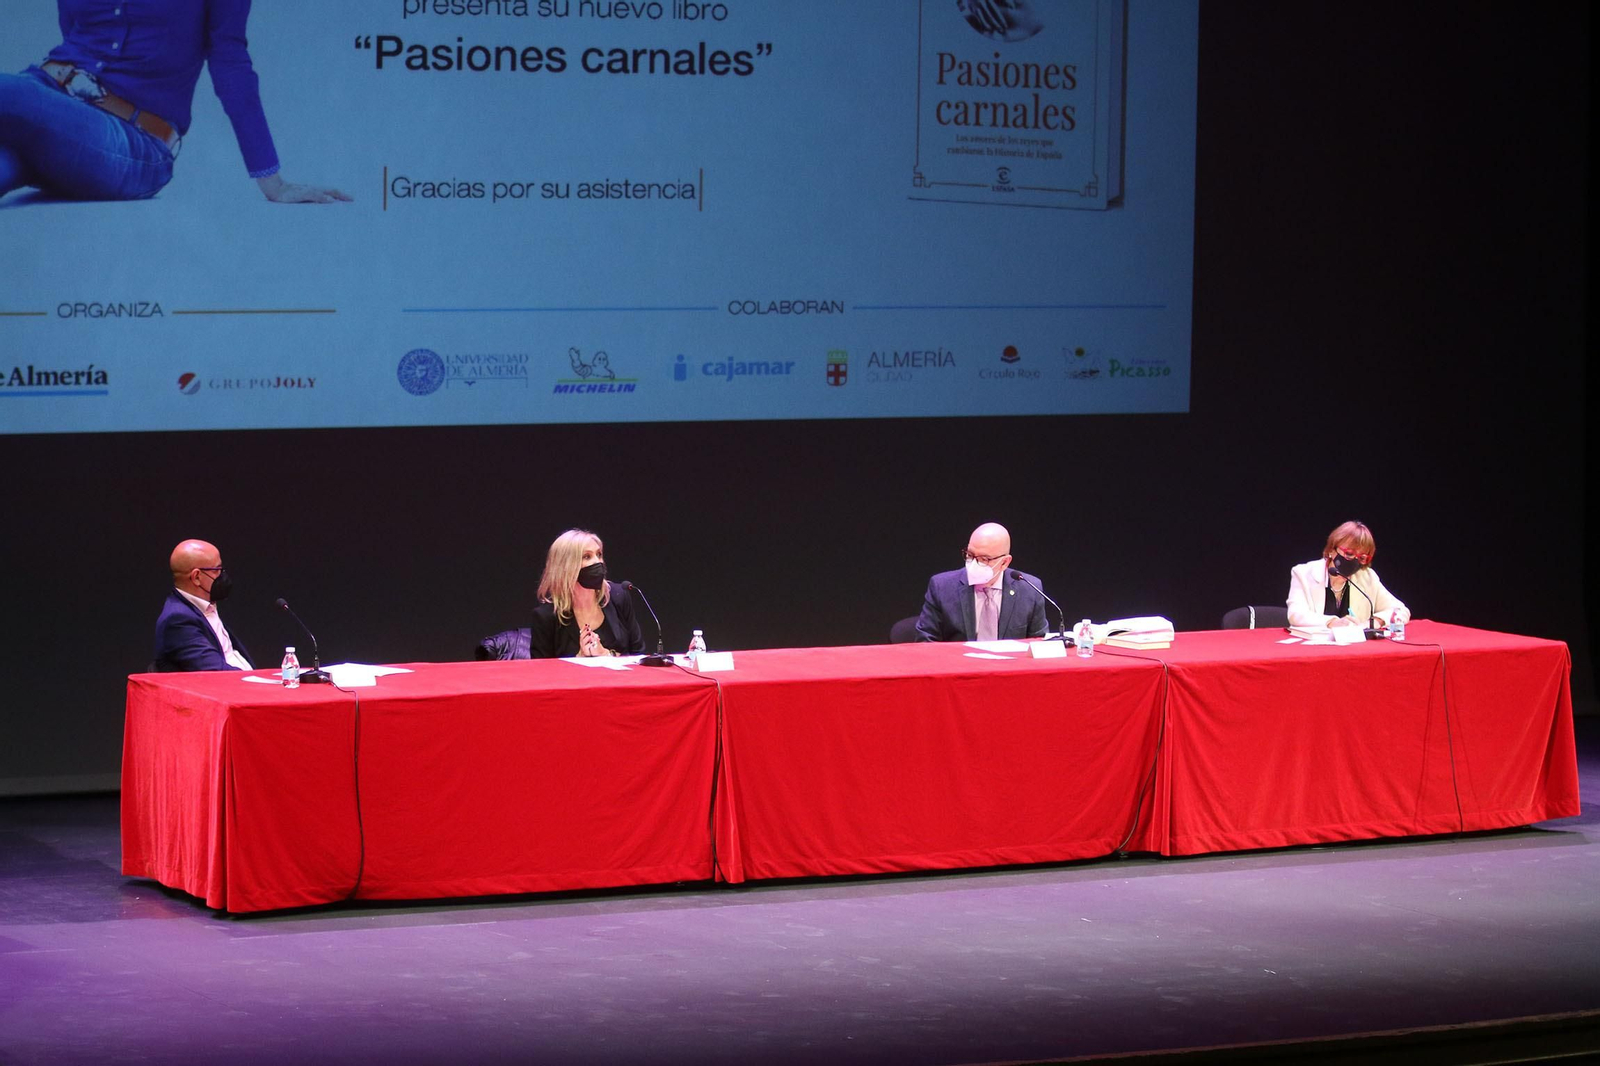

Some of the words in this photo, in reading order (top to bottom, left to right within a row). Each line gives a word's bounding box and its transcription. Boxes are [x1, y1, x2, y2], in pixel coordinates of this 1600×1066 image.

[403, 0, 528, 19] presenta
[538, 0, 569, 18] su
[580, 0, 662, 20] nuevo
[673, 0, 728, 21] libro
[936, 51, 1077, 90] Pasiones
[936, 93, 1076, 131] carnales
[391, 176, 485, 199] Gracias
[493, 181, 535, 203] por
[541, 181, 570, 199] su
[577, 177, 695, 200] asistencia
[57, 302, 164, 318] ORGANIZA
[728, 300, 844, 315] COLABORAN
[446, 354, 529, 365] UNIVERSIDAD
[867, 347, 956, 368] ALMERÍA
[1108, 358, 1171, 378] Picasso
[7, 364, 109, 386] Almería
[446, 366, 464, 377] DE
[702, 356, 796, 382] cajamar
[553, 383, 637, 395] MICHELIN
